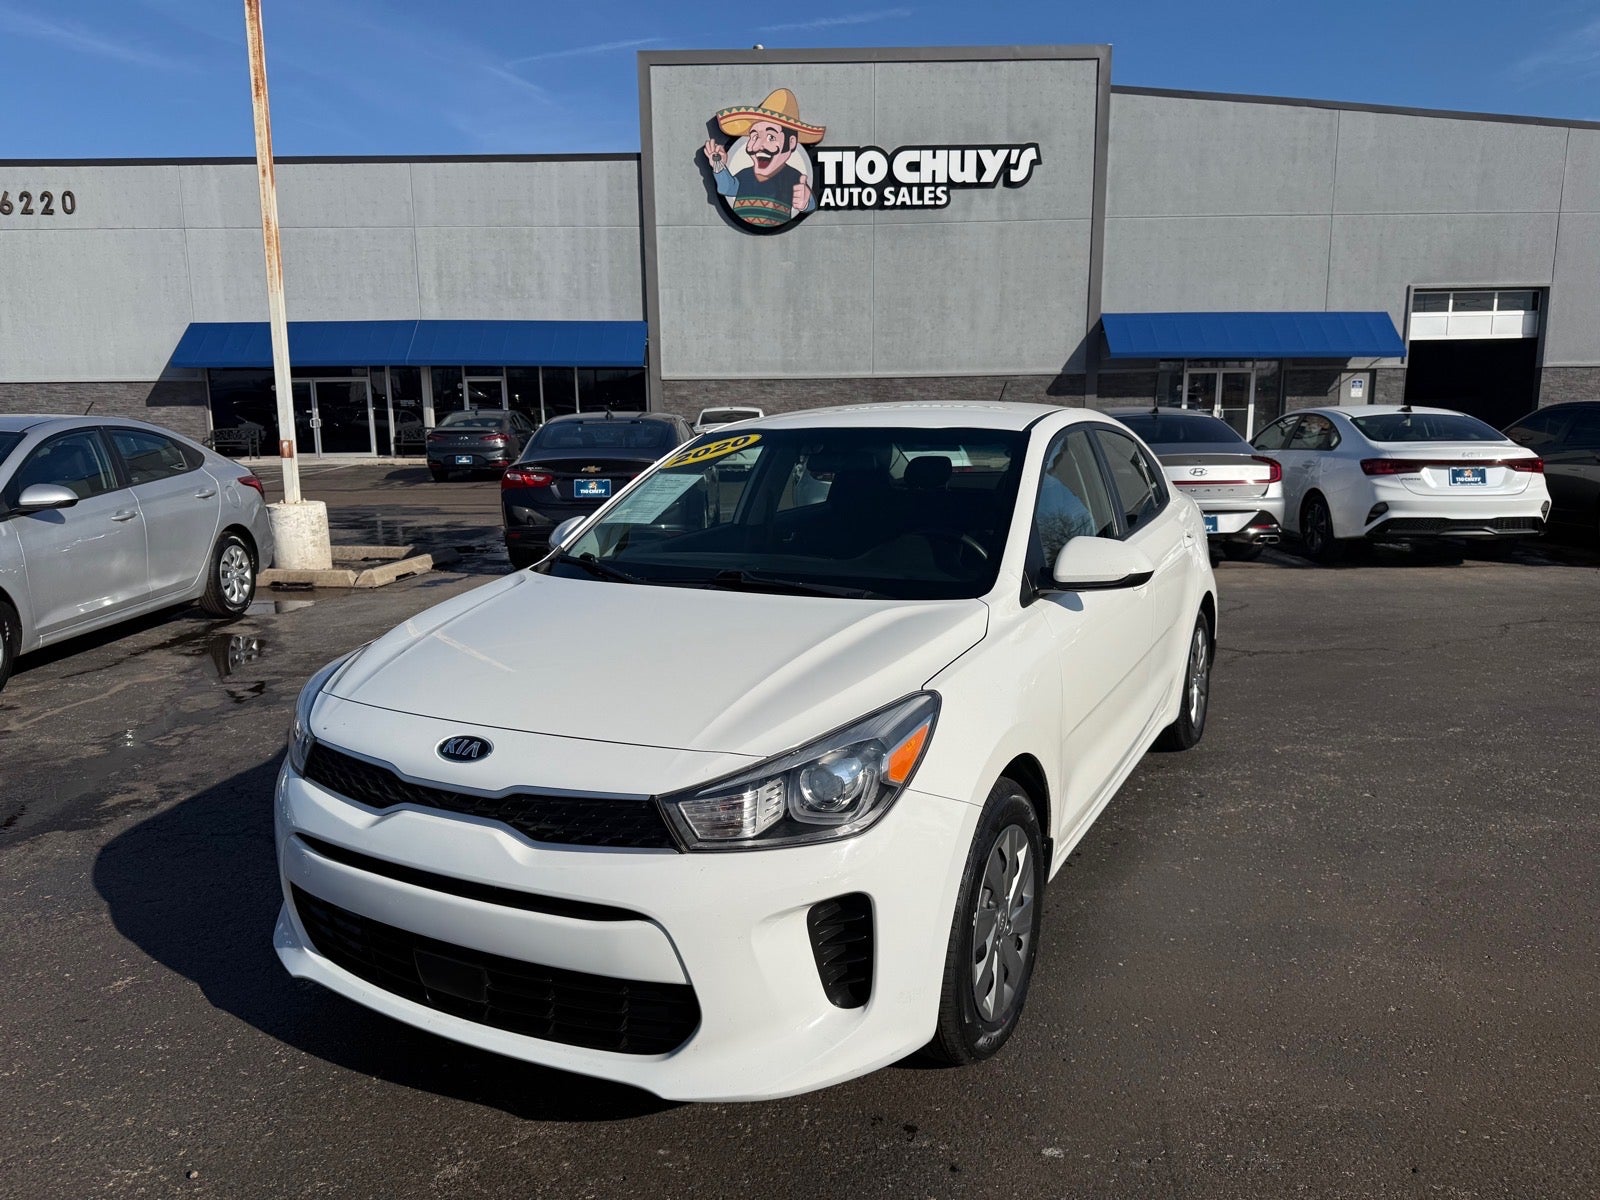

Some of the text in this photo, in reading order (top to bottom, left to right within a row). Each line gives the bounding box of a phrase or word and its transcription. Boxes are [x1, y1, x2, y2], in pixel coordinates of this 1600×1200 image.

[817, 147, 1038, 185] TIO CHUY'S
[0, 190, 76, 215] 6220
[820, 186, 948, 207] AUTO SALES
[670, 436, 751, 466] 2020
[442, 738, 481, 758] KIA
